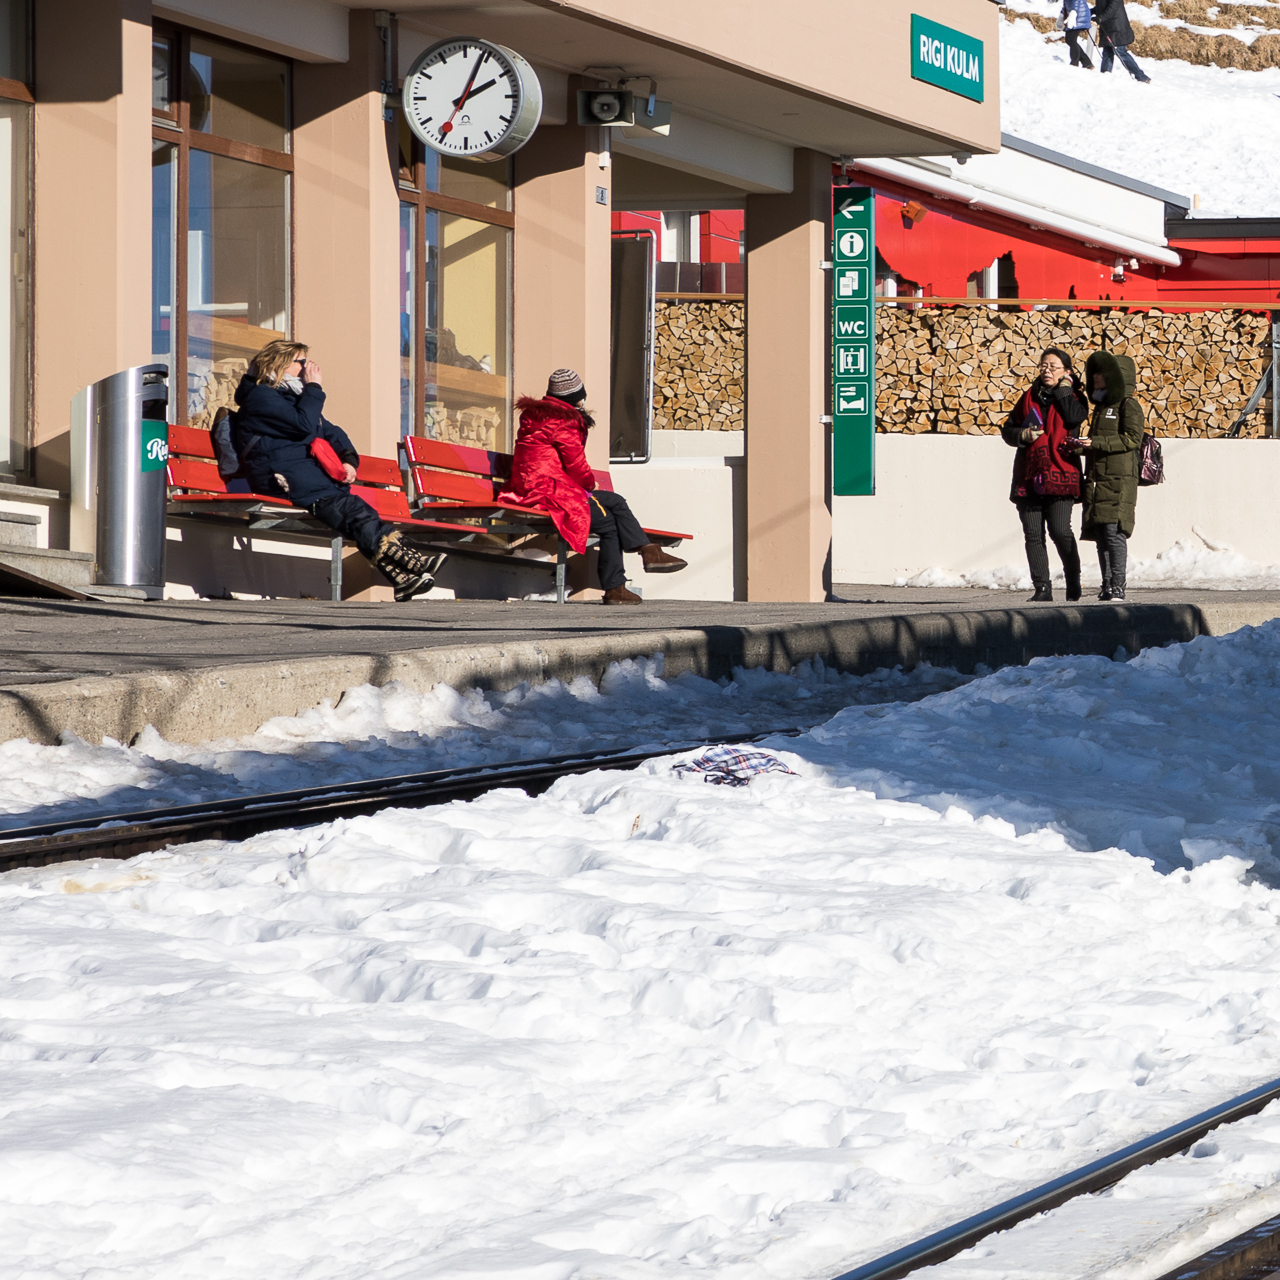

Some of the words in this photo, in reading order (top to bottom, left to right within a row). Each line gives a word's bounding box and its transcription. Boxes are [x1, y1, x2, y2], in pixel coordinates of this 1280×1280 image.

[920, 33, 945, 69] RIGI
[947, 44, 980, 83] KULM
[839, 321, 865, 335] WC
